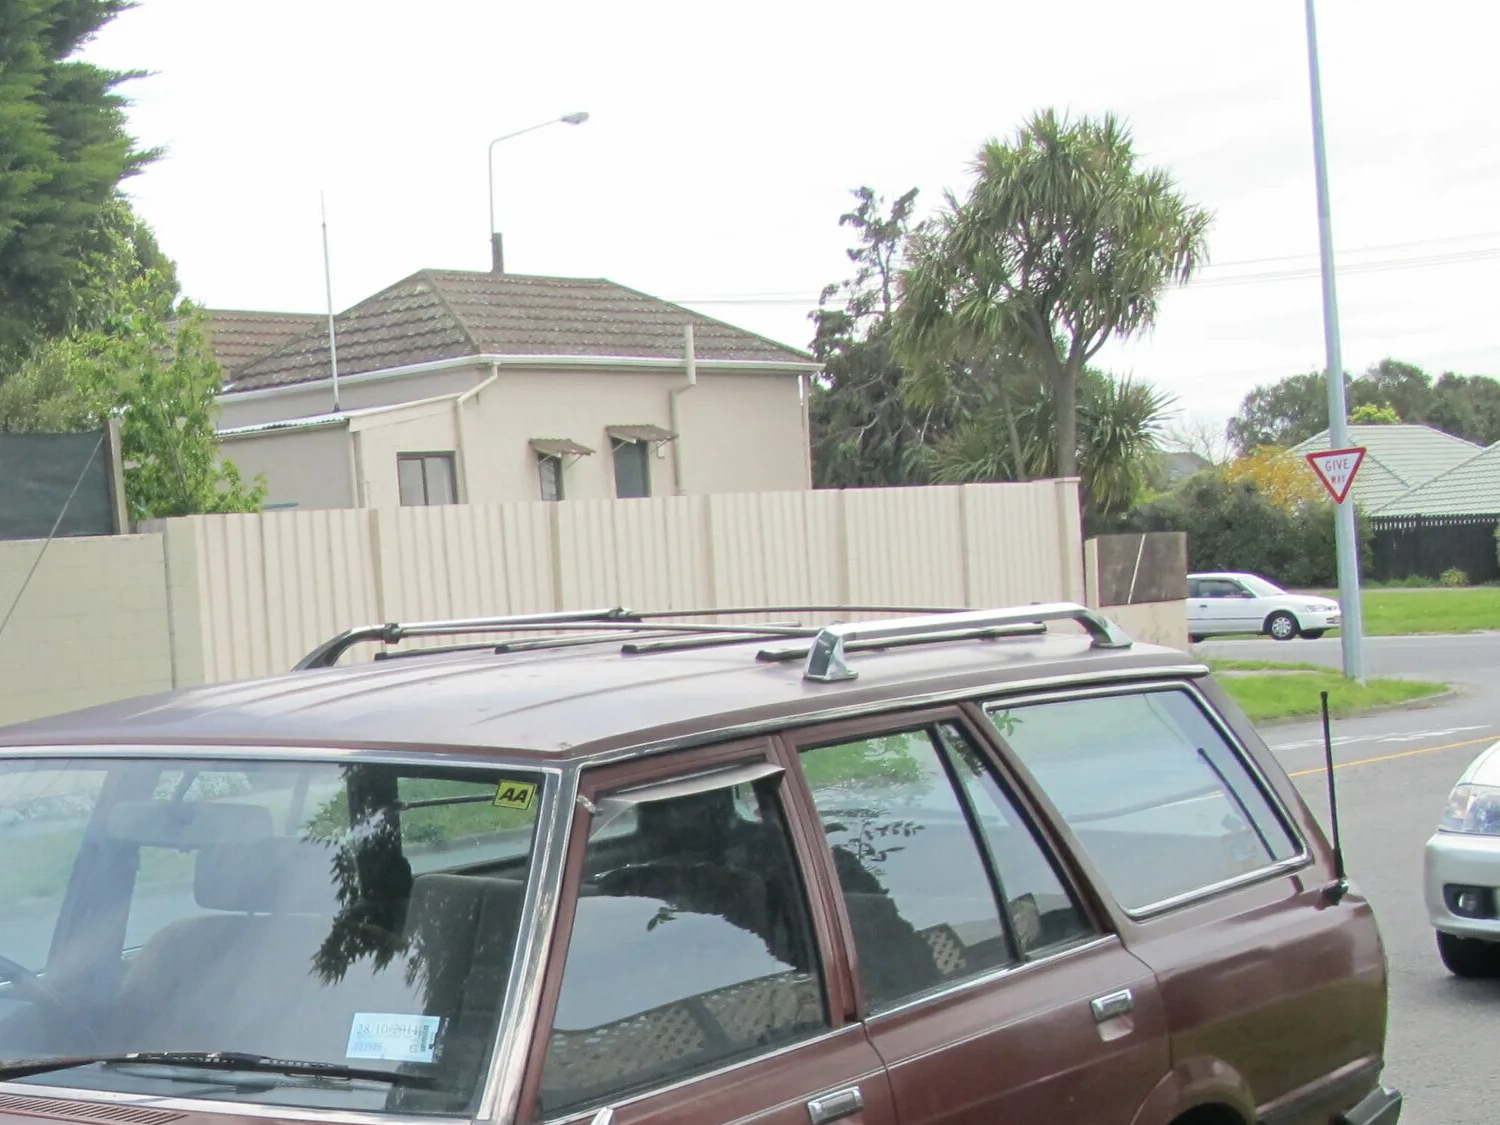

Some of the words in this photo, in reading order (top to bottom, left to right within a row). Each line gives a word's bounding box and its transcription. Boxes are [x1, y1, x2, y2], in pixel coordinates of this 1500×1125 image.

[1325, 458, 1350, 472] GIVE
[1331, 475, 1346, 484] WAY
[499, 787, 529, 803] AA
